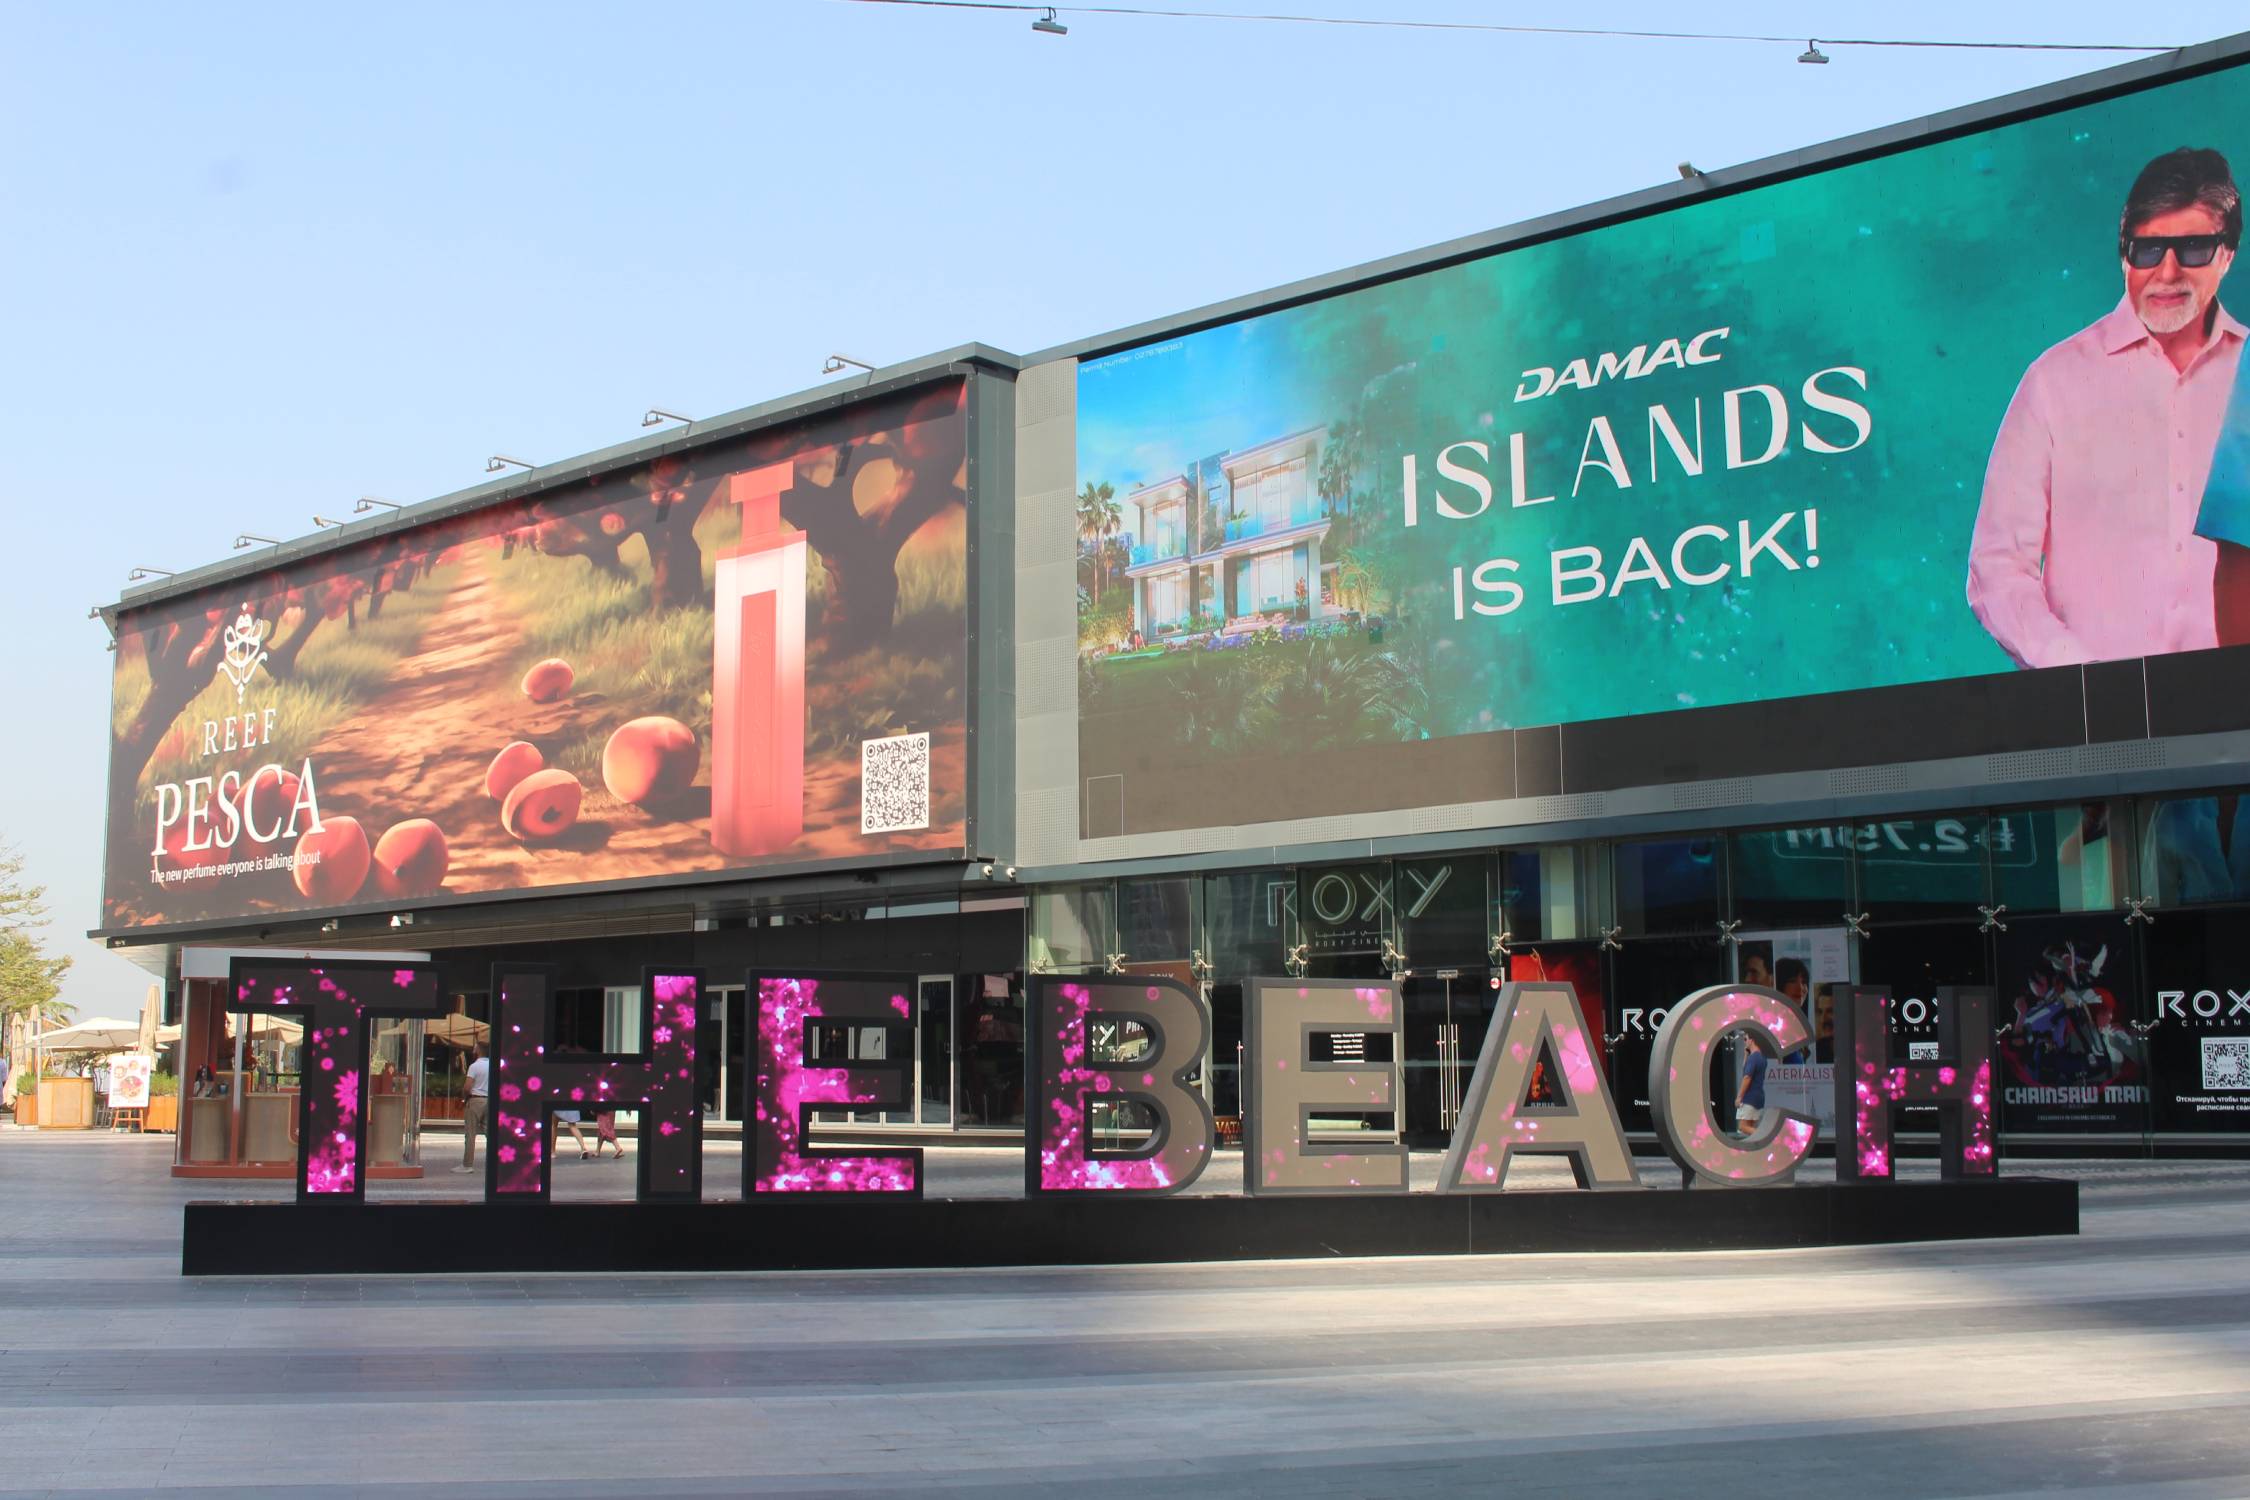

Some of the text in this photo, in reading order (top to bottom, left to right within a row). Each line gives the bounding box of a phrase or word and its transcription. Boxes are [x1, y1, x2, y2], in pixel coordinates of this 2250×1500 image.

[1513, 326, 1730, 403] DAMAC
[1402, 366, 1872, 527] ISLANDS
[1452, 508, 1821, 621] IS BACK!
[202, 708, 277, 756] REEF
[151, 757, 326, 857] PESCA
[150, 868, 165, 883] The
[165, 869, 183, 882] new
[183, 862, 216, 883] perfume
[217, 860, 255, 877] everyone
[255, 857, 264, 871] is
[264, 853, 293, 871] talking
[1267, 865, 1453, 928] ROXY
[1351, 936, 1380, 947] CINE
[2157, 988, 2250, 1019] ROX
[2181, 1018, 2250, 1027] CINEM
[227, 954, 1997, 1203] THE BEACH
[2004, 1085, 2151, 1105] CHAINSAW MAN
